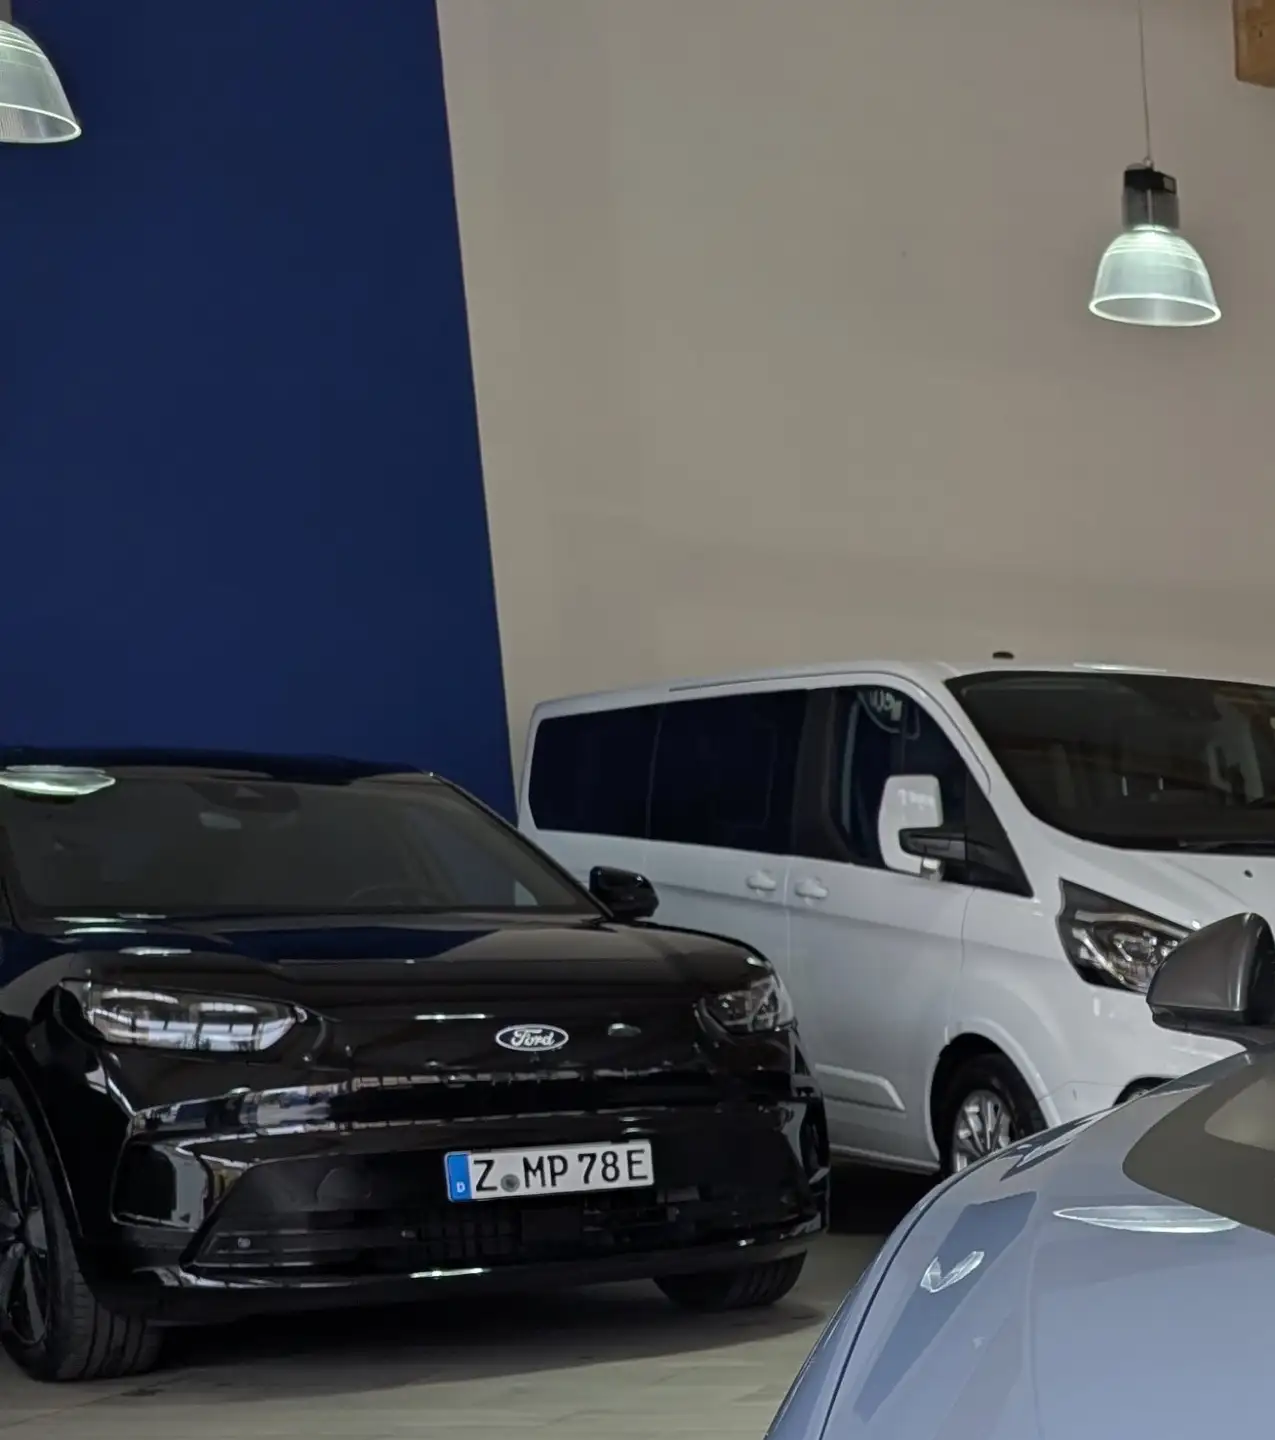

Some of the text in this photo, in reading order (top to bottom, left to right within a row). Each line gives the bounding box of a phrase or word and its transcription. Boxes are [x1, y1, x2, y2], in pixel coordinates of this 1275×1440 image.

[510, 1028, 556, 1047] Ford
[473, 1149, 648, 1192] Z MP 78E
[456, 1181, 466, 1193] D
